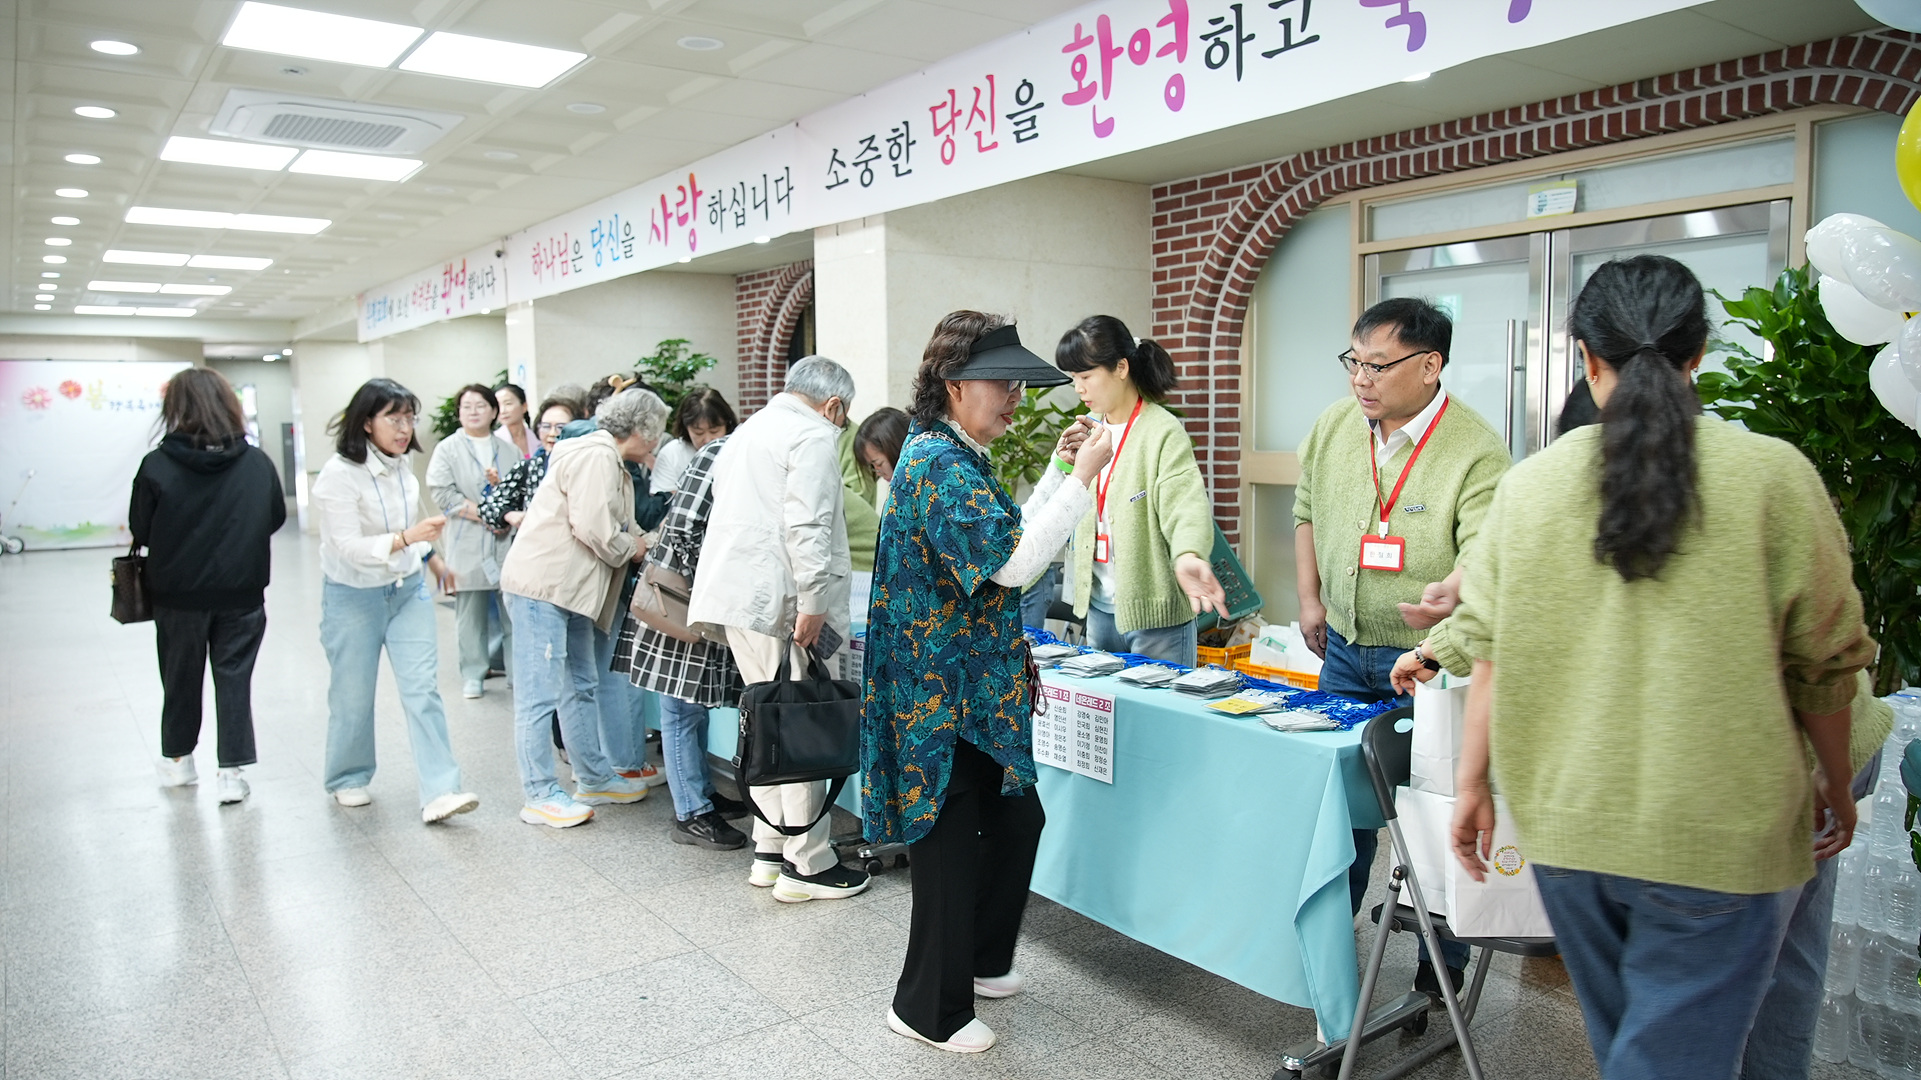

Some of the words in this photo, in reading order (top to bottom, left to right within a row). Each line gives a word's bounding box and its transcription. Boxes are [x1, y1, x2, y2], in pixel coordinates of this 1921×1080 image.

[825, 120, 917, 190] 소중한
[929, 74, 1045, 165] 당신을
[531, 231, 584, 285] 하나님은
[590, 213, 636, 268] 당신을
[648, 166, 795, 252] 사랑하십니다
